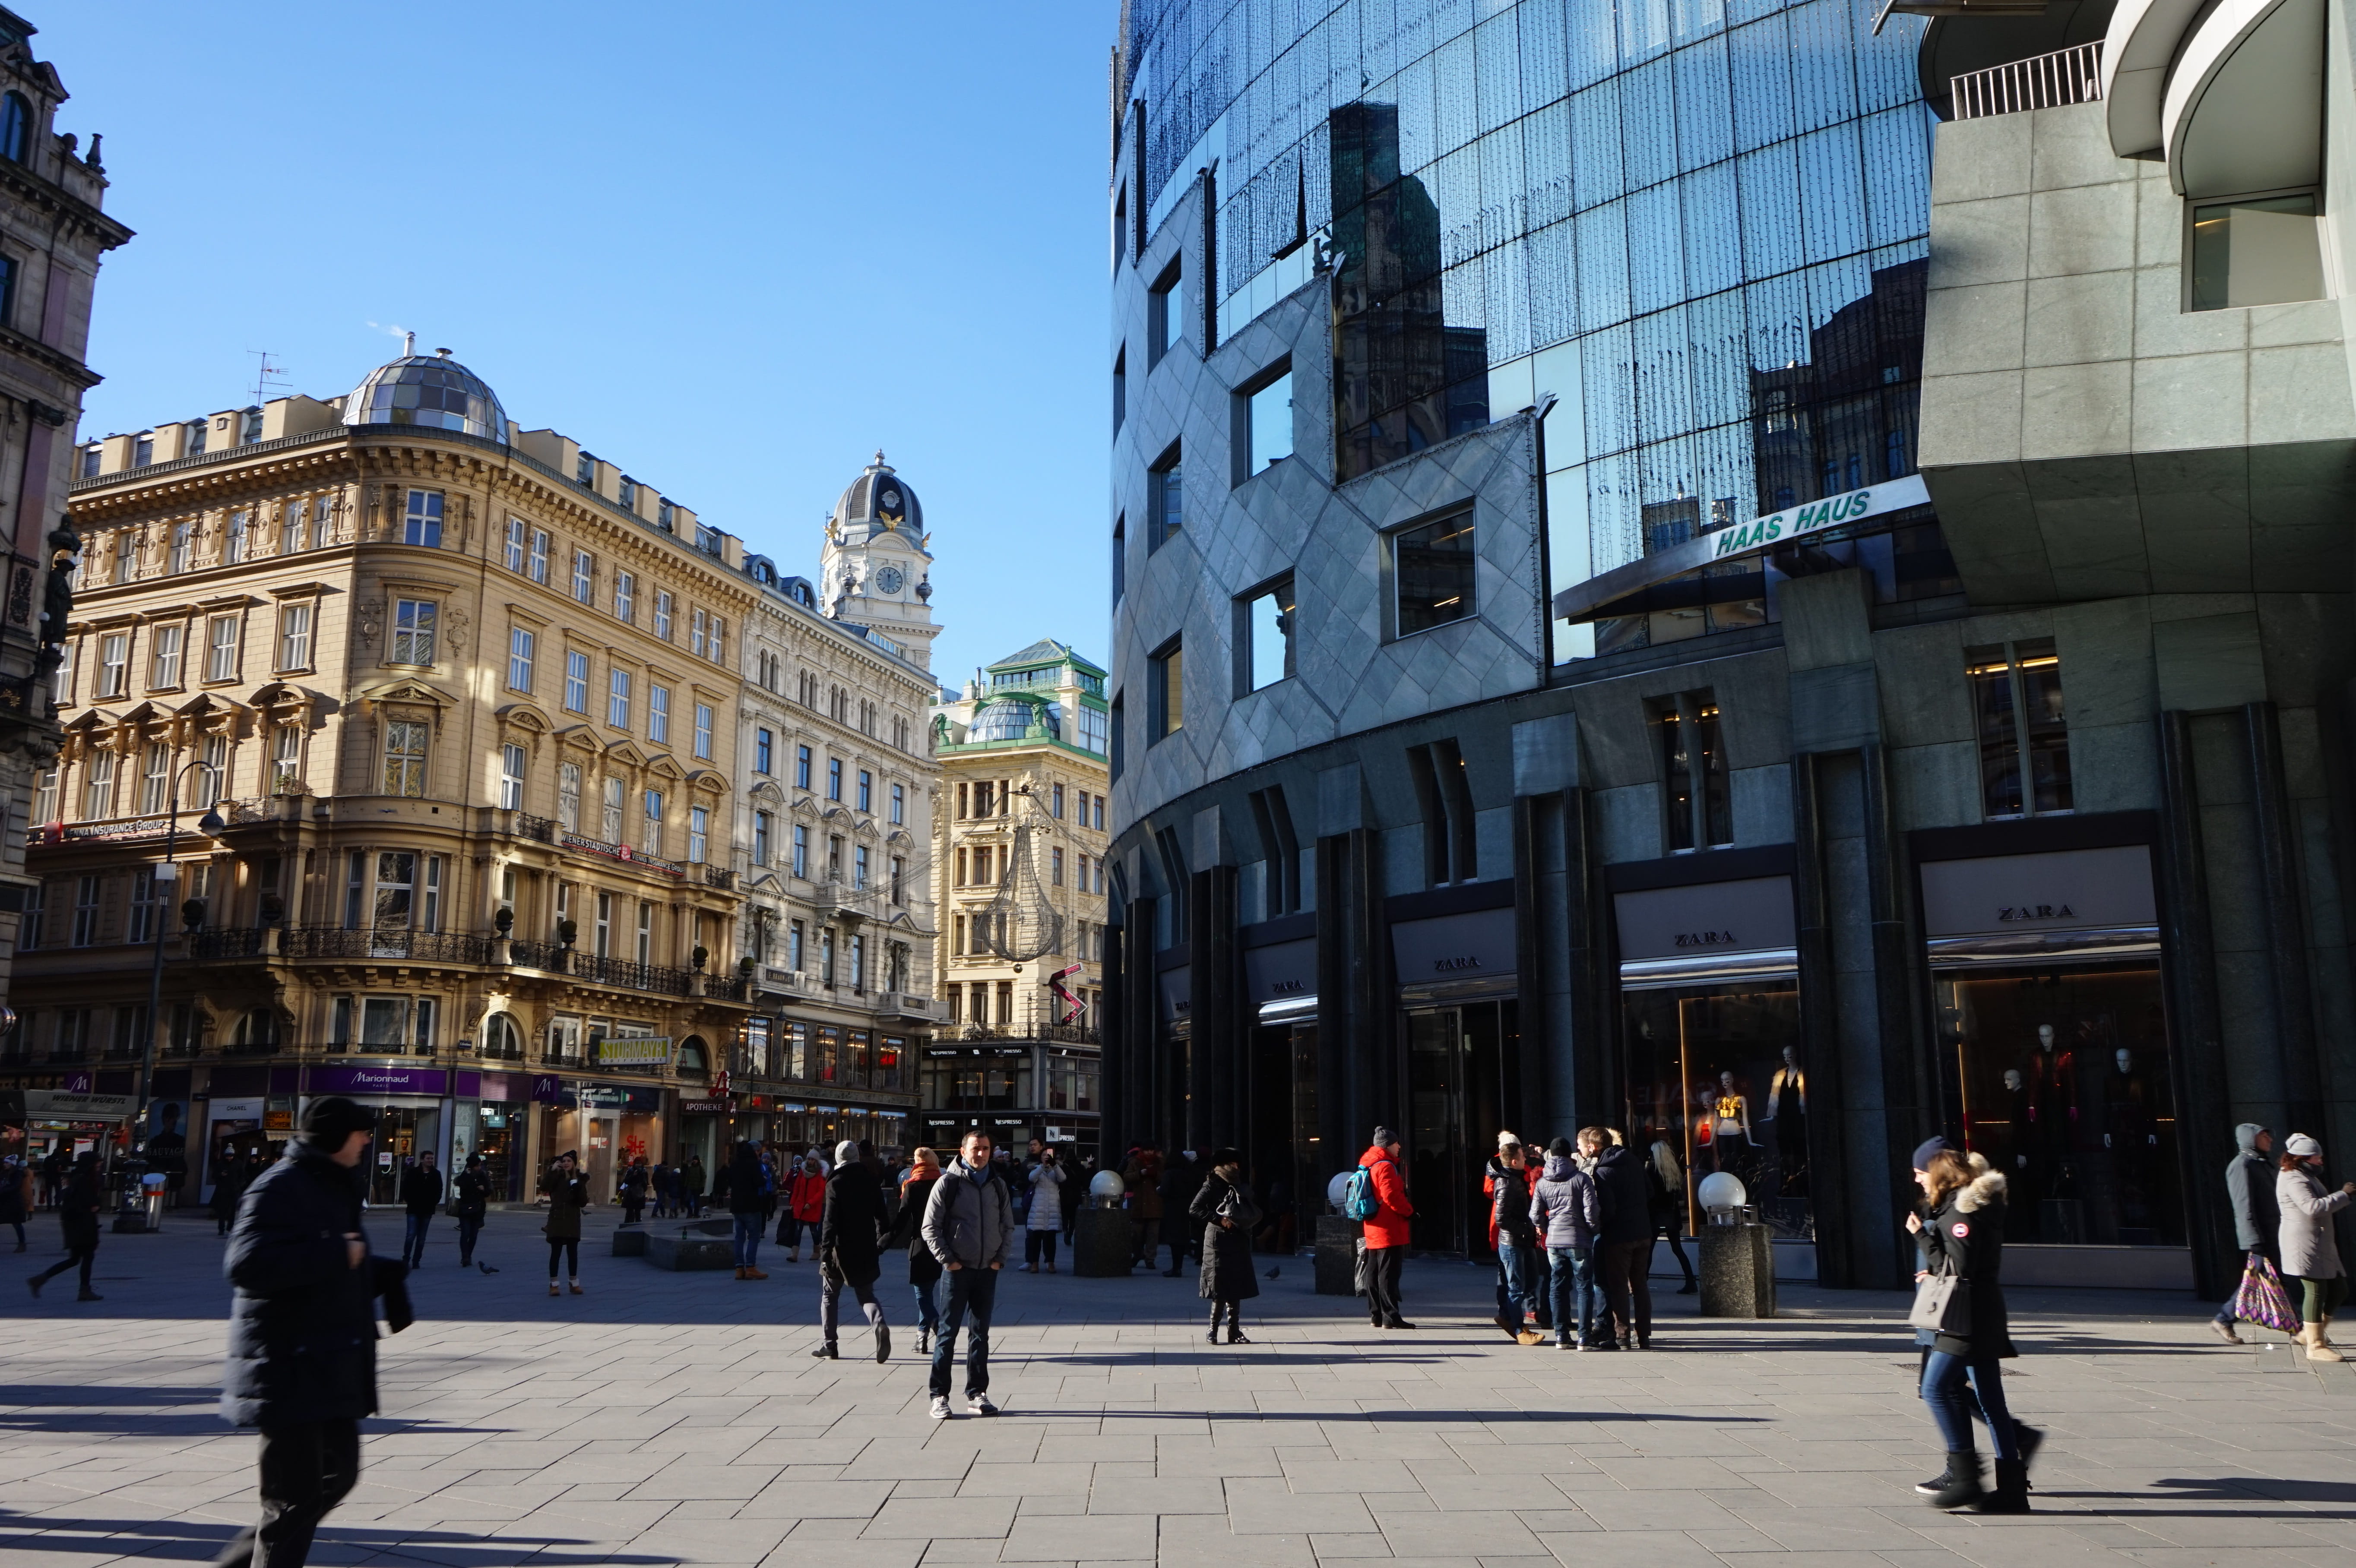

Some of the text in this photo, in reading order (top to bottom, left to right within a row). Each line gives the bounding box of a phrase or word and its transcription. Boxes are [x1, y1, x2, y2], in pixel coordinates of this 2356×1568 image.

[1716, 491, 1870, 556] HAAS HAUS
[64, 819, 165, 838] VIENNA INSURANCE GROUP
[561, 834, 585, 847] WIENER
[632, 852, 647, 863] VIENNA
[648, 857, 671, 870] INSURANCE
[1999, 904, 2077, 920] ZARA
[1675, 931, 1736, 945] ZARA
[1434, 956, 1481, 970] ZARA
[1273, 980, 1305, 992] ZARA
[604, 1040, 663, 1059] STURMAYR
[351, 1072, 409, 1084] Marionnaud
[535, 1078, 551, 1095] M
[52, 1094, 126, 1104] WIENER WÜRSTL
[1049, 1129, 1055, 1138] N
[148, 1147, 184, 1156] SAUVAGE
